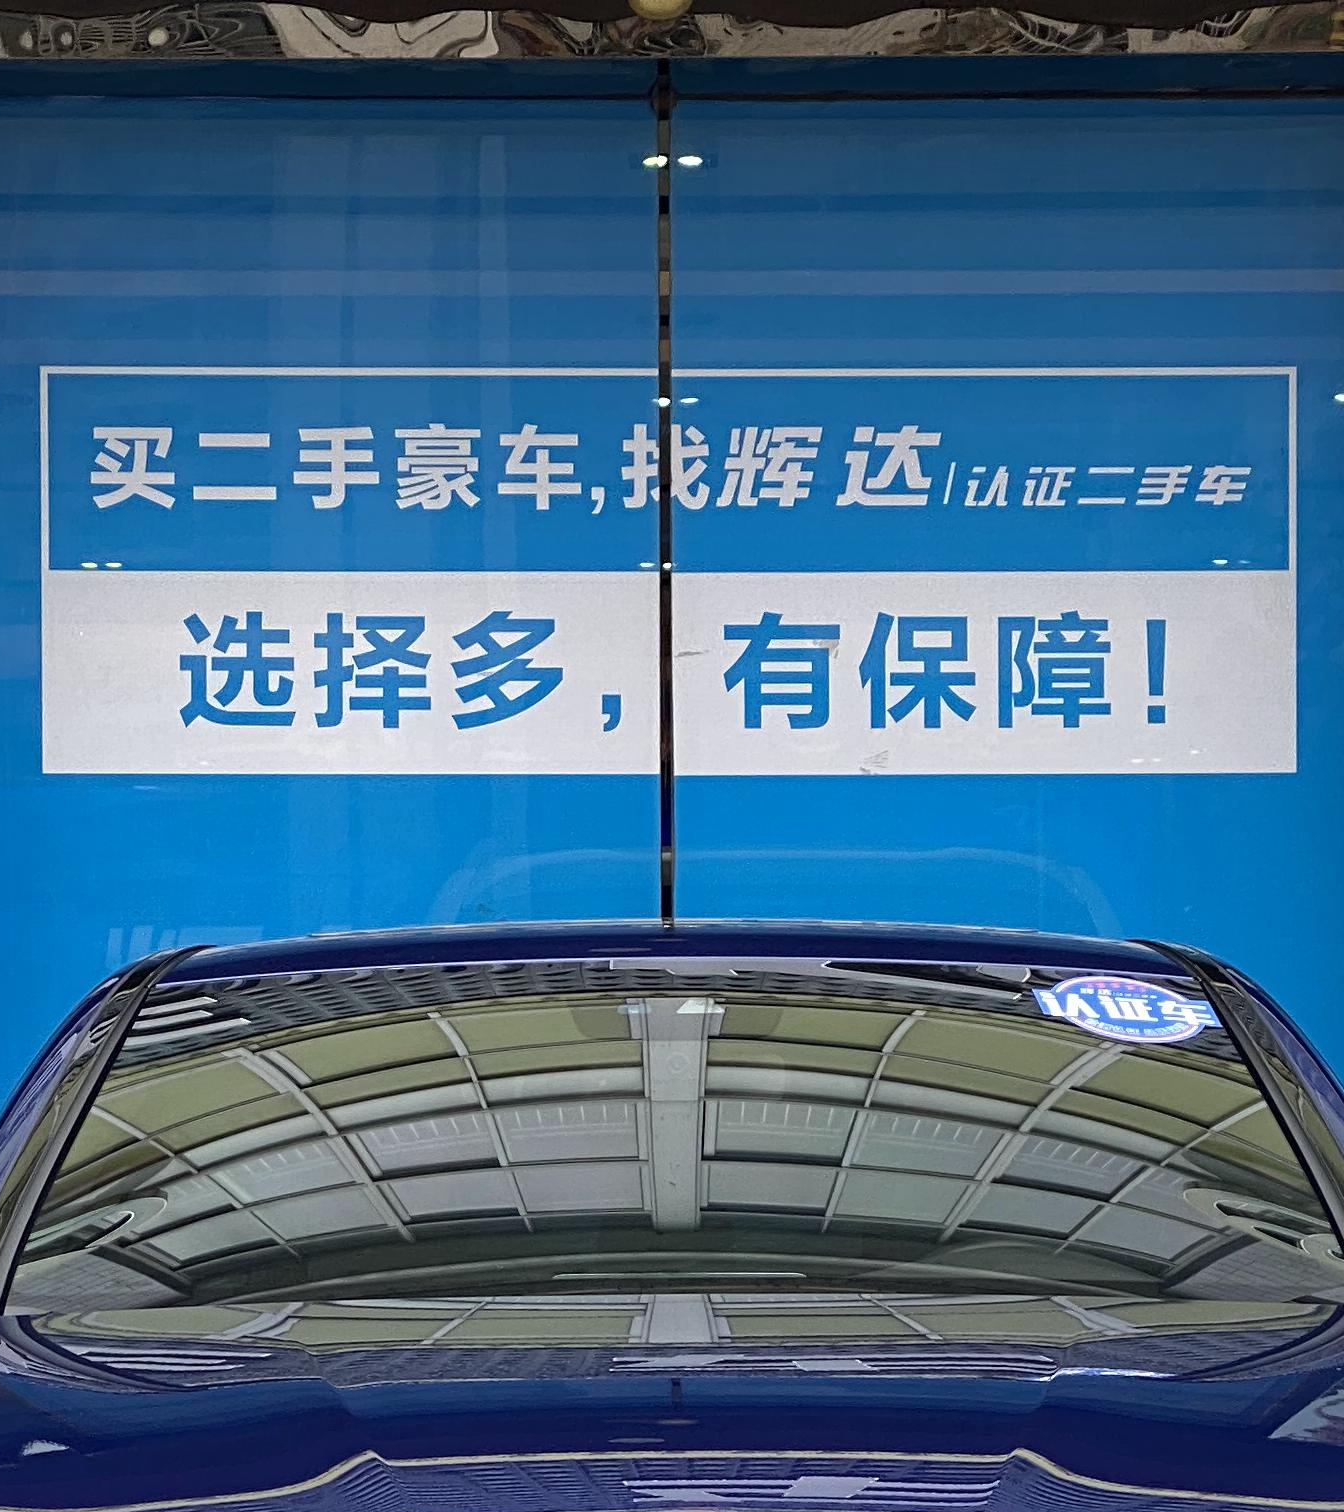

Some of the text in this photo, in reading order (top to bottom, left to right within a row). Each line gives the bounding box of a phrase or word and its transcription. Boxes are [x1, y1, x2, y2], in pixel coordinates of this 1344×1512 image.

[964, 465, 1252, 507] 认证二手车
